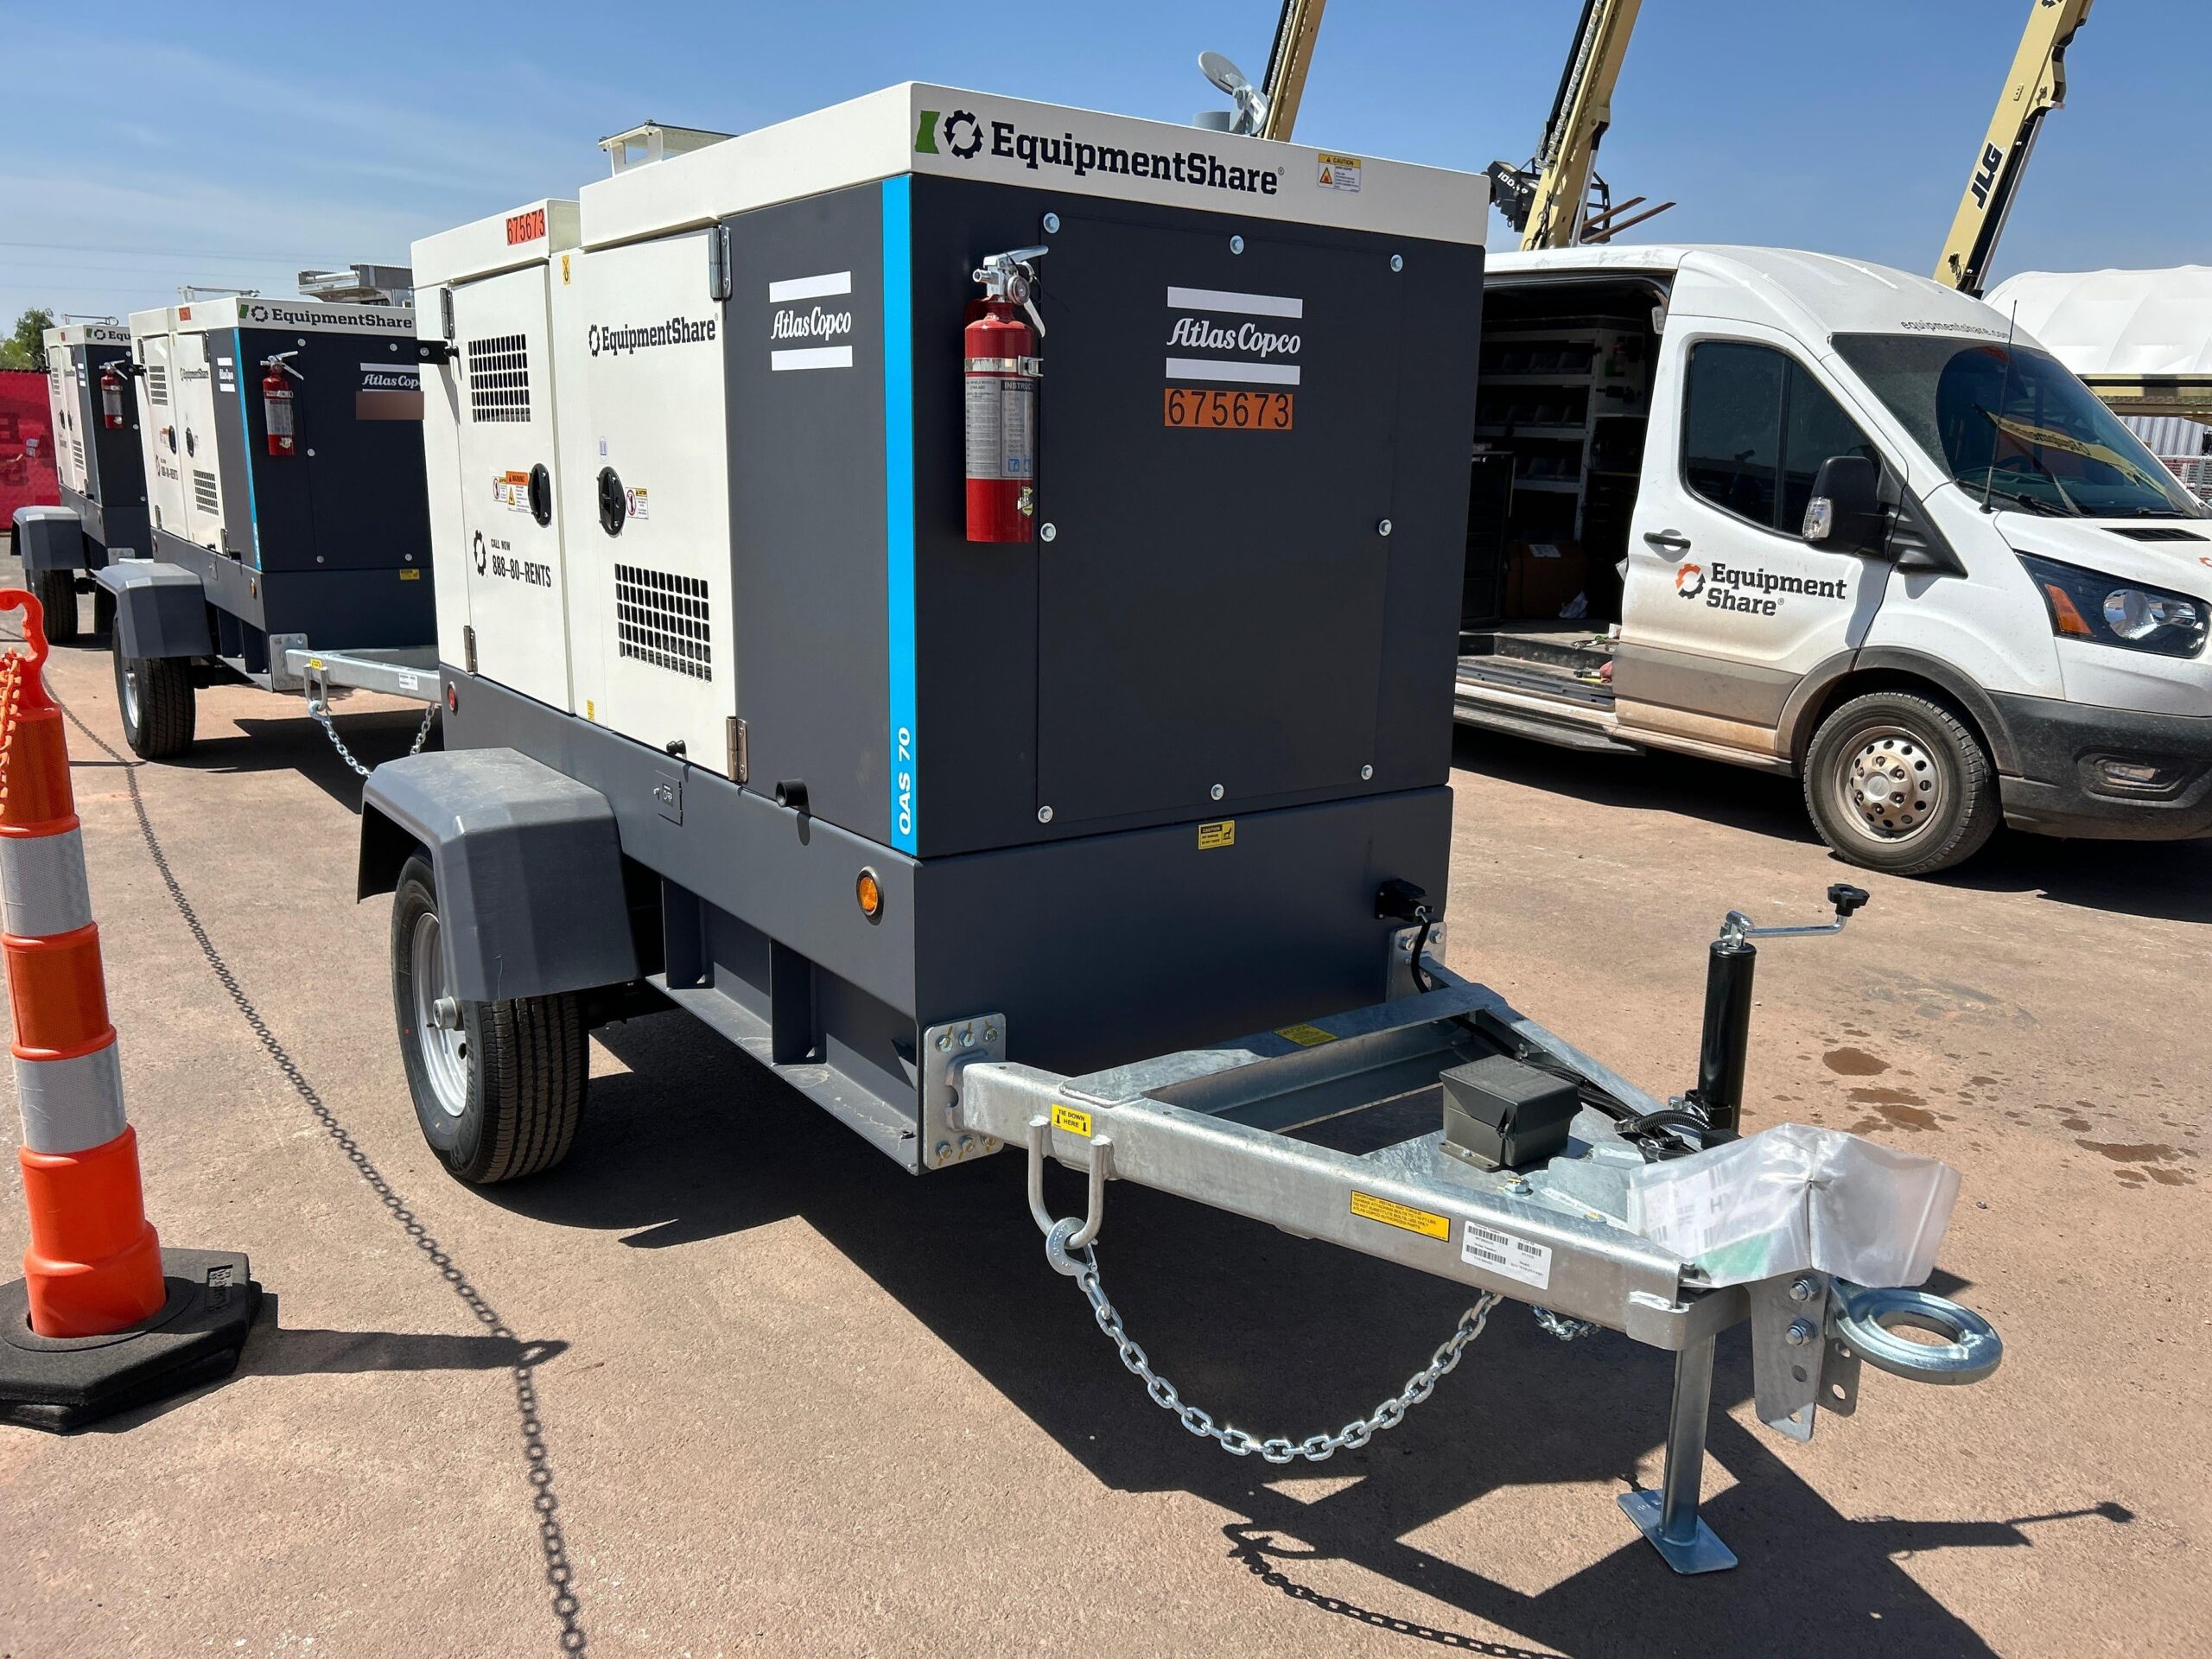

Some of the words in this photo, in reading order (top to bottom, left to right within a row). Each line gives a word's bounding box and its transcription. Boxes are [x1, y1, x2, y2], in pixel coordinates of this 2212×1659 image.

[1971, 142, 2004, 211] JLG
[507, 208, 545, 245] 675673
[1168, 389, 1290, 428] 675673
[491, 537, 500, 550] CALL
[501, 540, 511, 551] NOW
[492, 554, 551, 588] 888-80-RENTS
[1711, 562, 1847, 600] Equipment
[898, 727, 911, 762] 70
[899, 772, 912, 836] QAS
[1063, 1119, 1079, 1128] HERE
[1067, 1111, 1085, 1122] DOWN
